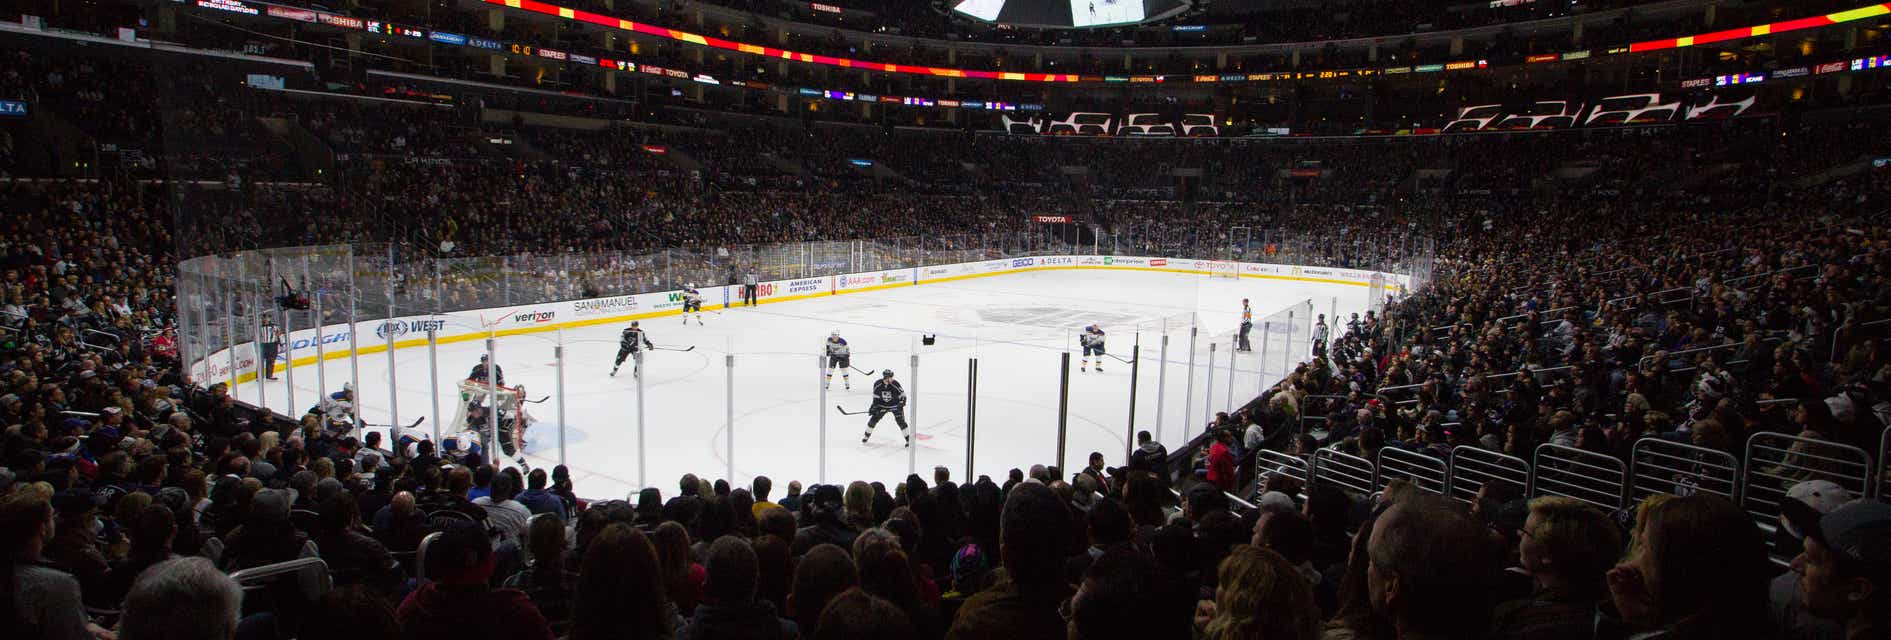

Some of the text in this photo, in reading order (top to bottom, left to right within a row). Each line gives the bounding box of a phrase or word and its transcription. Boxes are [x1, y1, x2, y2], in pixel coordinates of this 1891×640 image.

[814, 3, 841, 13] TOSHIBA
[664, 69, 688, 79] TOYOTA
[1013, 258, 1034, 267] GEICO
[1047, 257, 1072, 265] DELTA
[789, 279, 823, 288] AMERICAN
[573, 296, 637, 312] SAN MANUEL
[514, 310, 554, 323] verizon
[410, 319, 446, 333] WEST
